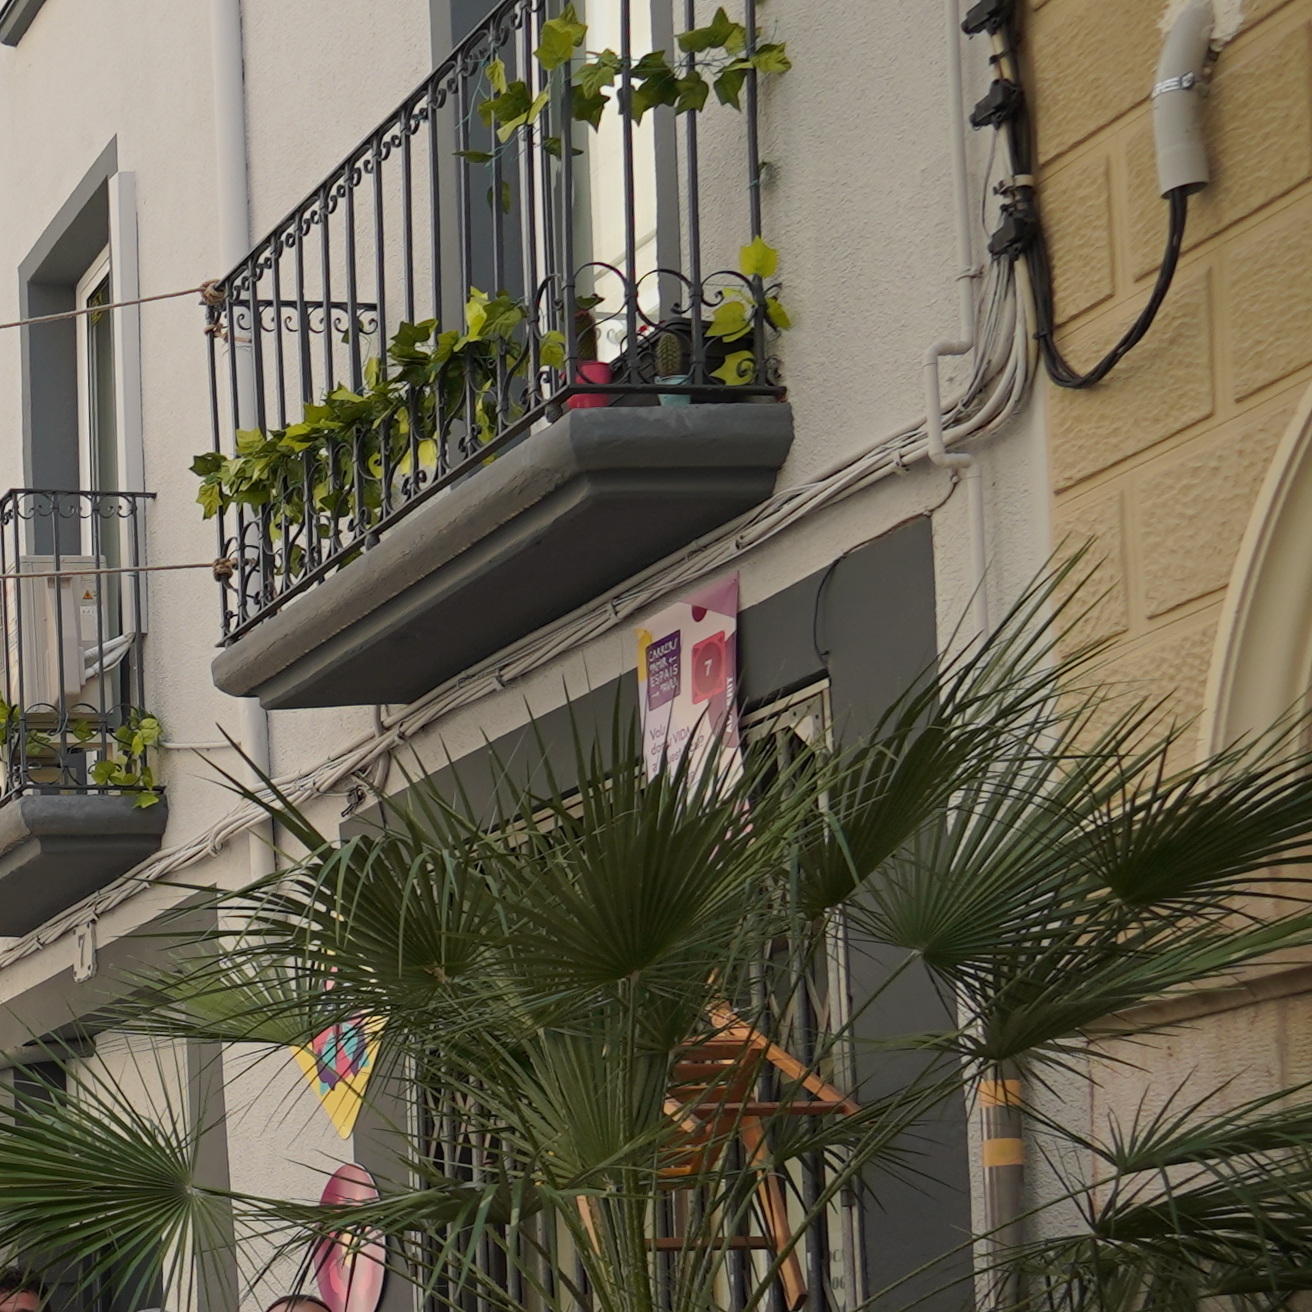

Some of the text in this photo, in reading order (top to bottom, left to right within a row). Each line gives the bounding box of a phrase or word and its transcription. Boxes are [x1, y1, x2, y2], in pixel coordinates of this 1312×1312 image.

[650, 664, 679, 687] ESPAIS
[703, 658, 713, 677] 7
[78, 932, 86, 969] 7
